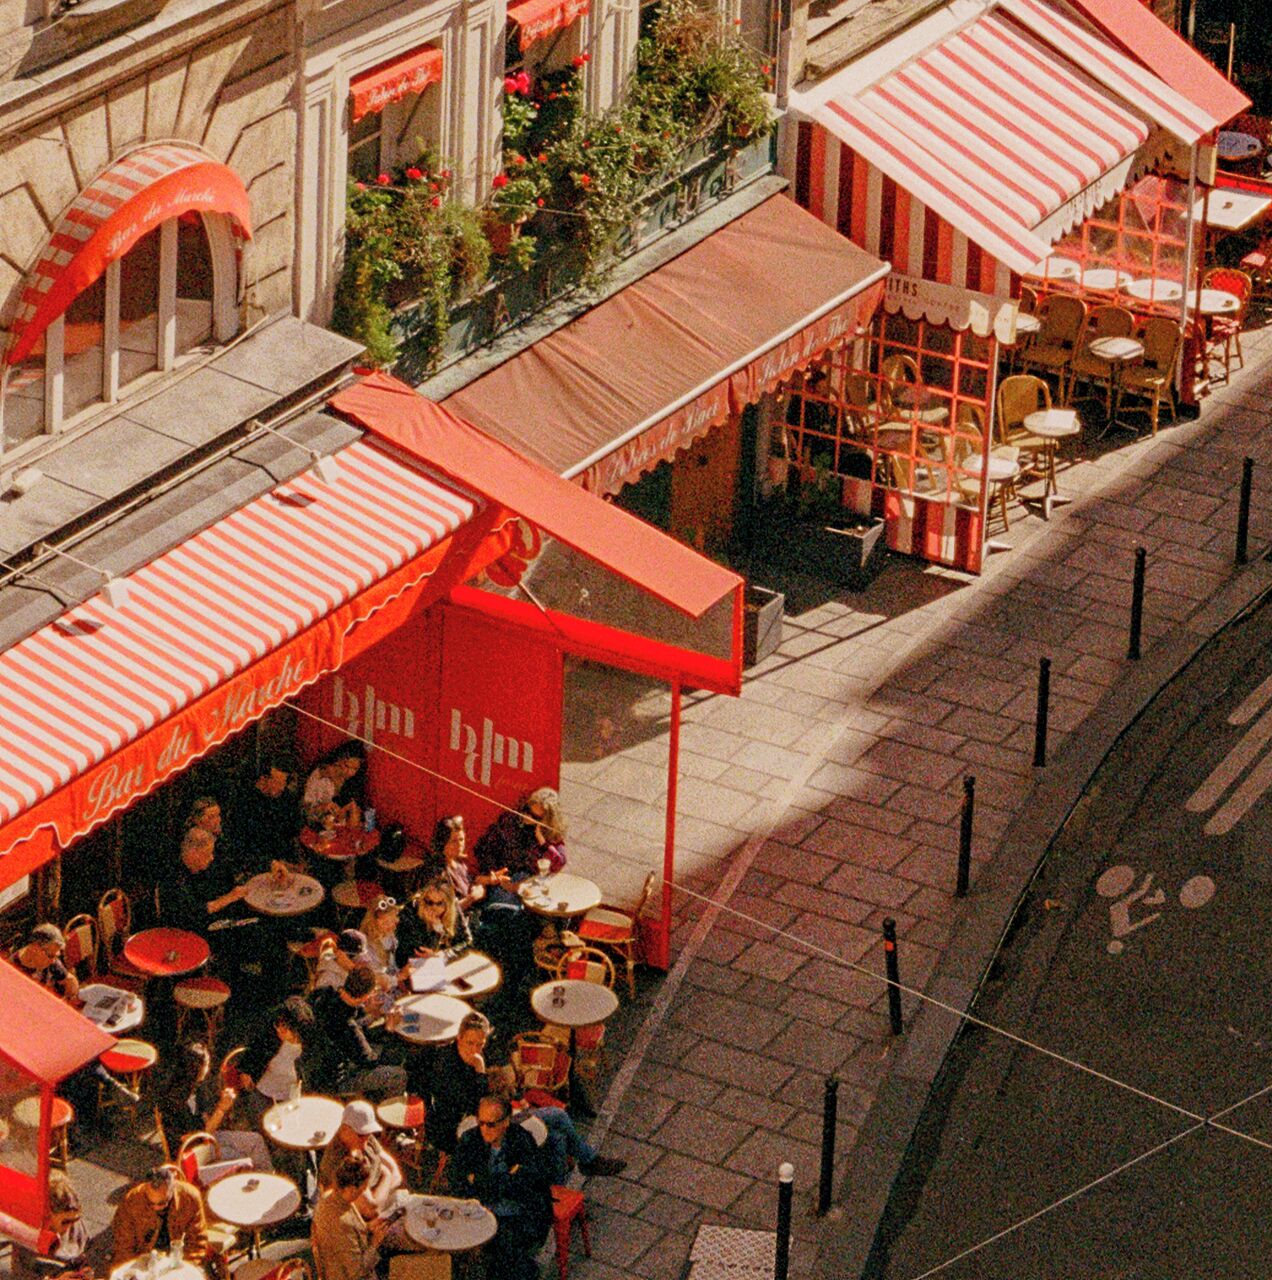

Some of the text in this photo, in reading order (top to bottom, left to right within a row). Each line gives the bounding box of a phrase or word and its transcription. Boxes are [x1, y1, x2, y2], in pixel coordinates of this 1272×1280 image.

[106, 223, 138, 258] Bar
[143, 201, 161, 223] du
[889, 277, 918, 297] ITHS
[84, 763, 145, 820] Bar
[157, 725, 192, 771] du
